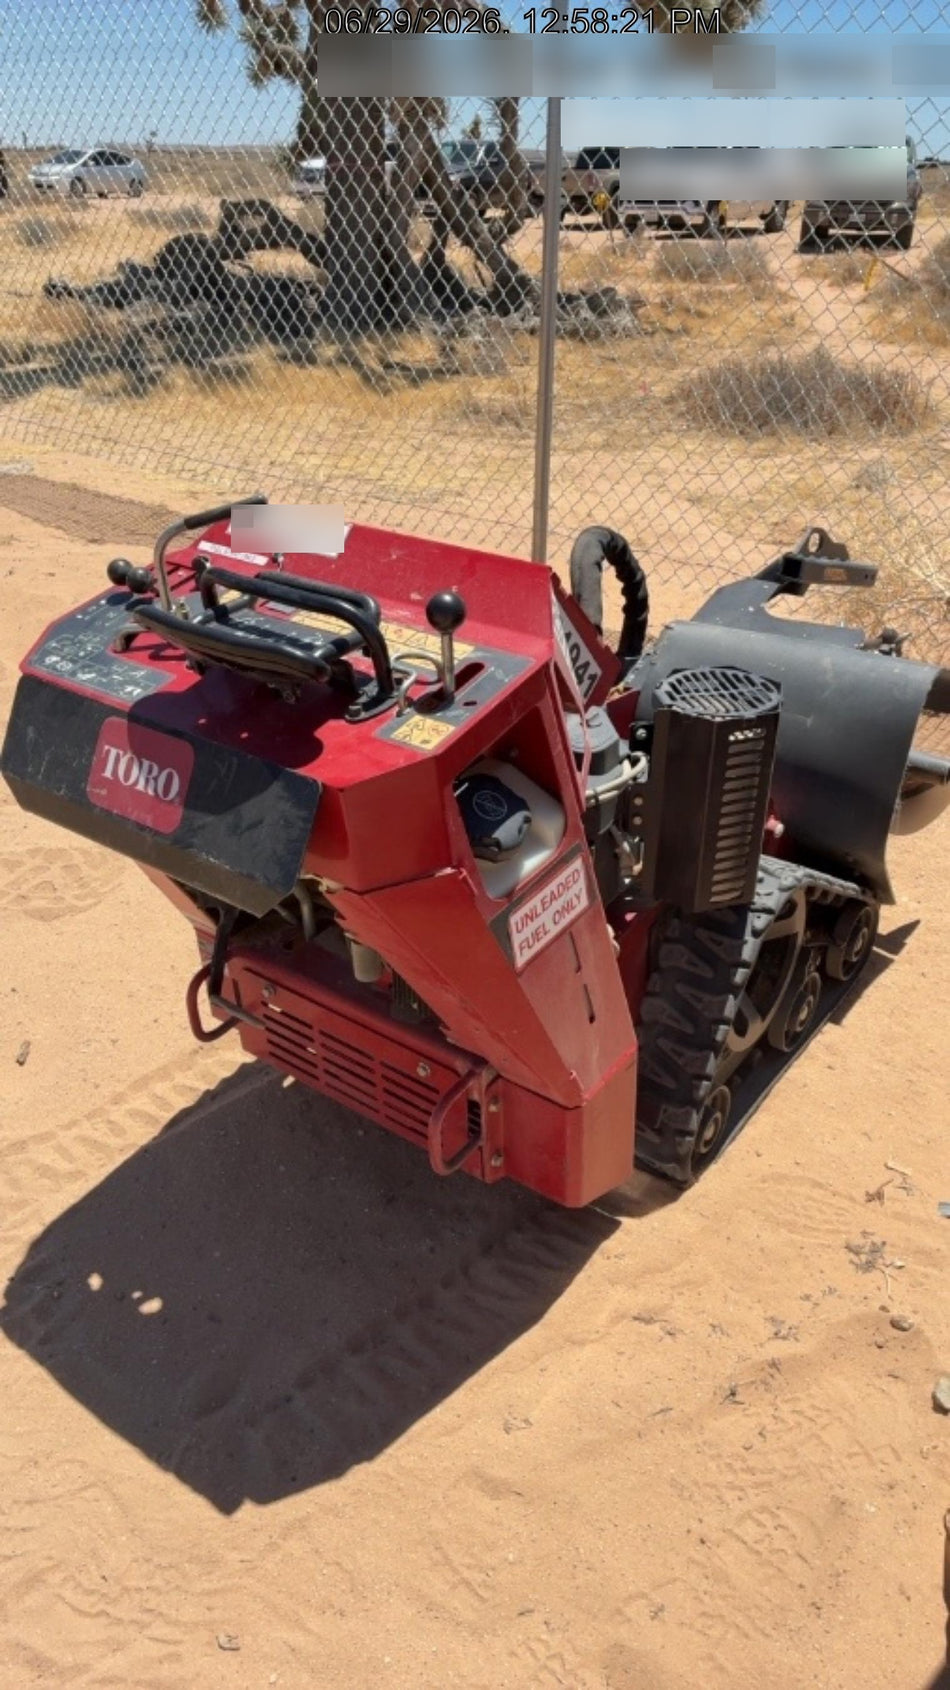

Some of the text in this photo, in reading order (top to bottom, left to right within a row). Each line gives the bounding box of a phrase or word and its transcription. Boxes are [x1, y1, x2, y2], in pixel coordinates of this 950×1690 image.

[564, 630, 599, 699] 941
[101, 744, 180, 801] TORO
[514, 869, 581, 934] UNLEADED
[518, 887, 583, 957] FUEL ONLY
